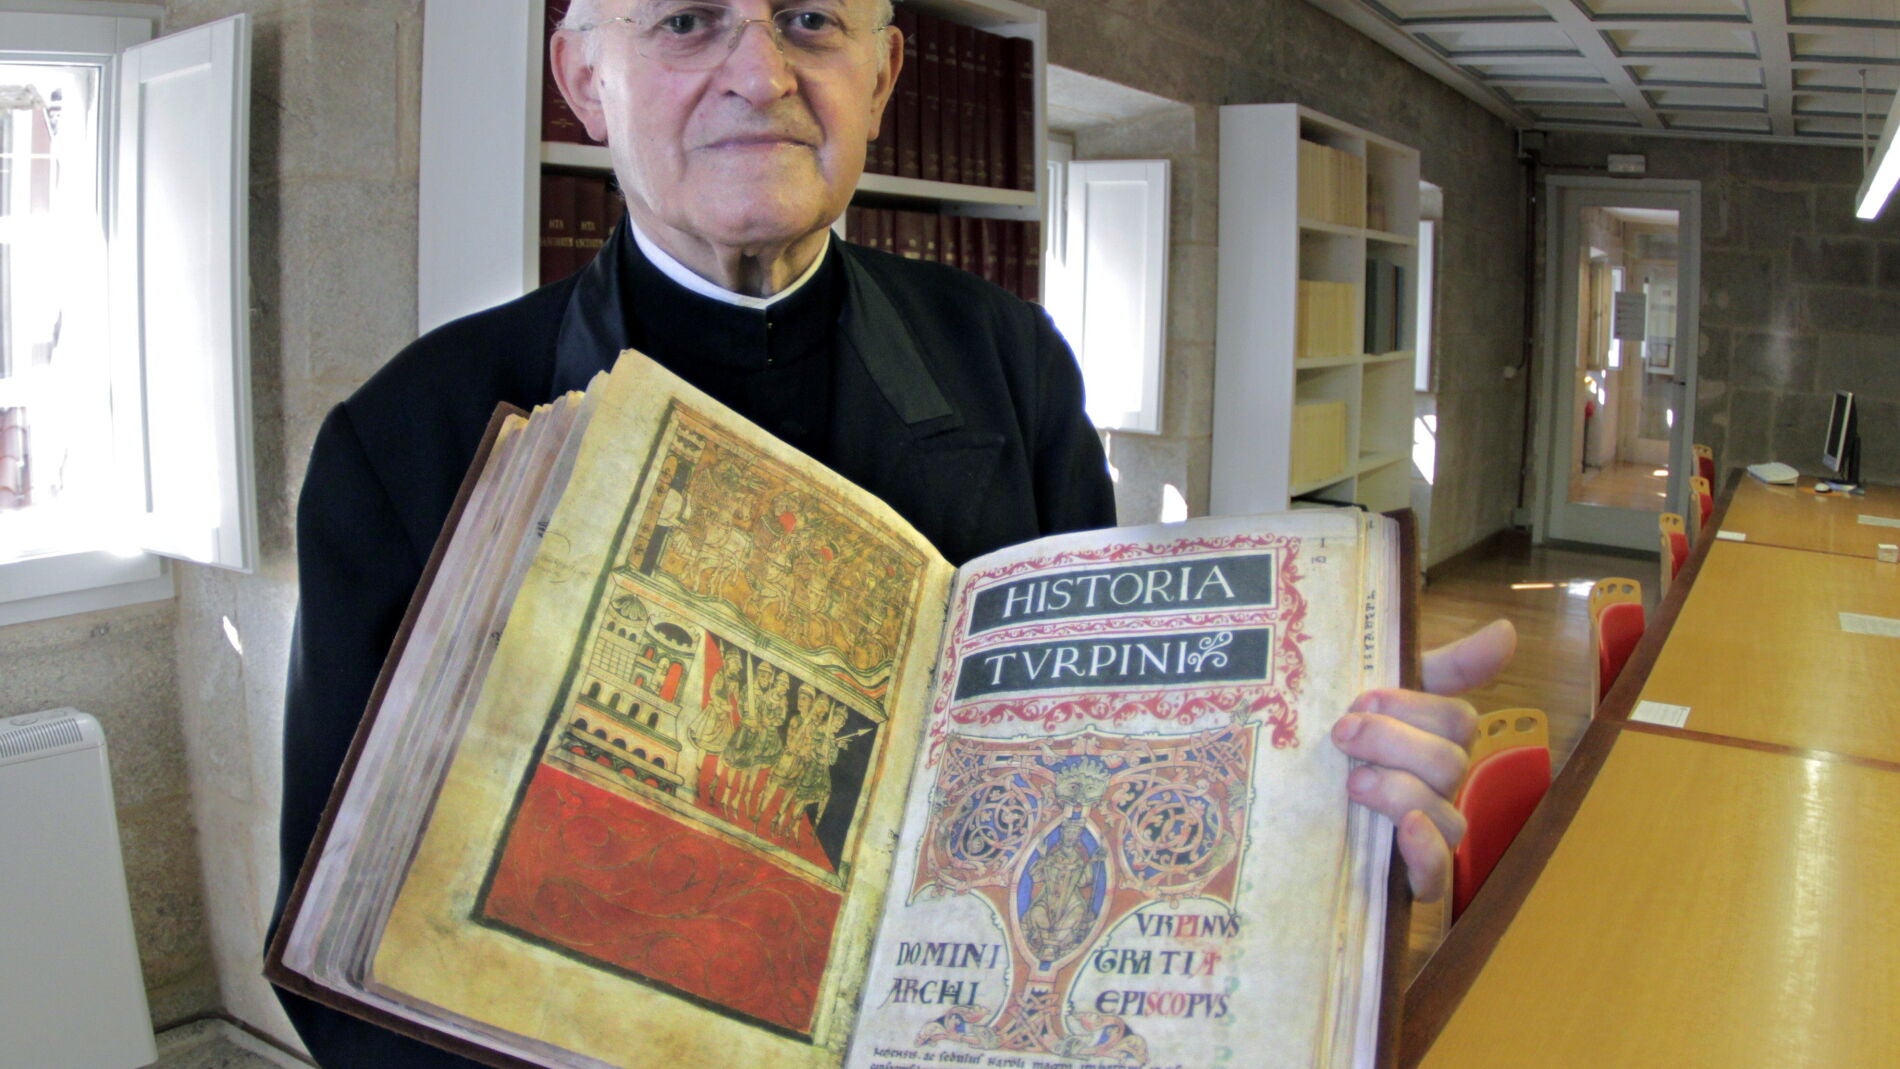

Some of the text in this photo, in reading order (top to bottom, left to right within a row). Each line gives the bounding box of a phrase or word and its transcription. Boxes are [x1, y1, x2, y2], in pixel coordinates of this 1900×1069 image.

[1001, 565, 1236, 619] HISTORIA
[984, 641, 1188, 686] TVRPINI
[895, 942, 1002, 969] DOMINI
[879, 977, 1231, 1018] ARCHI EPISCOPVS
